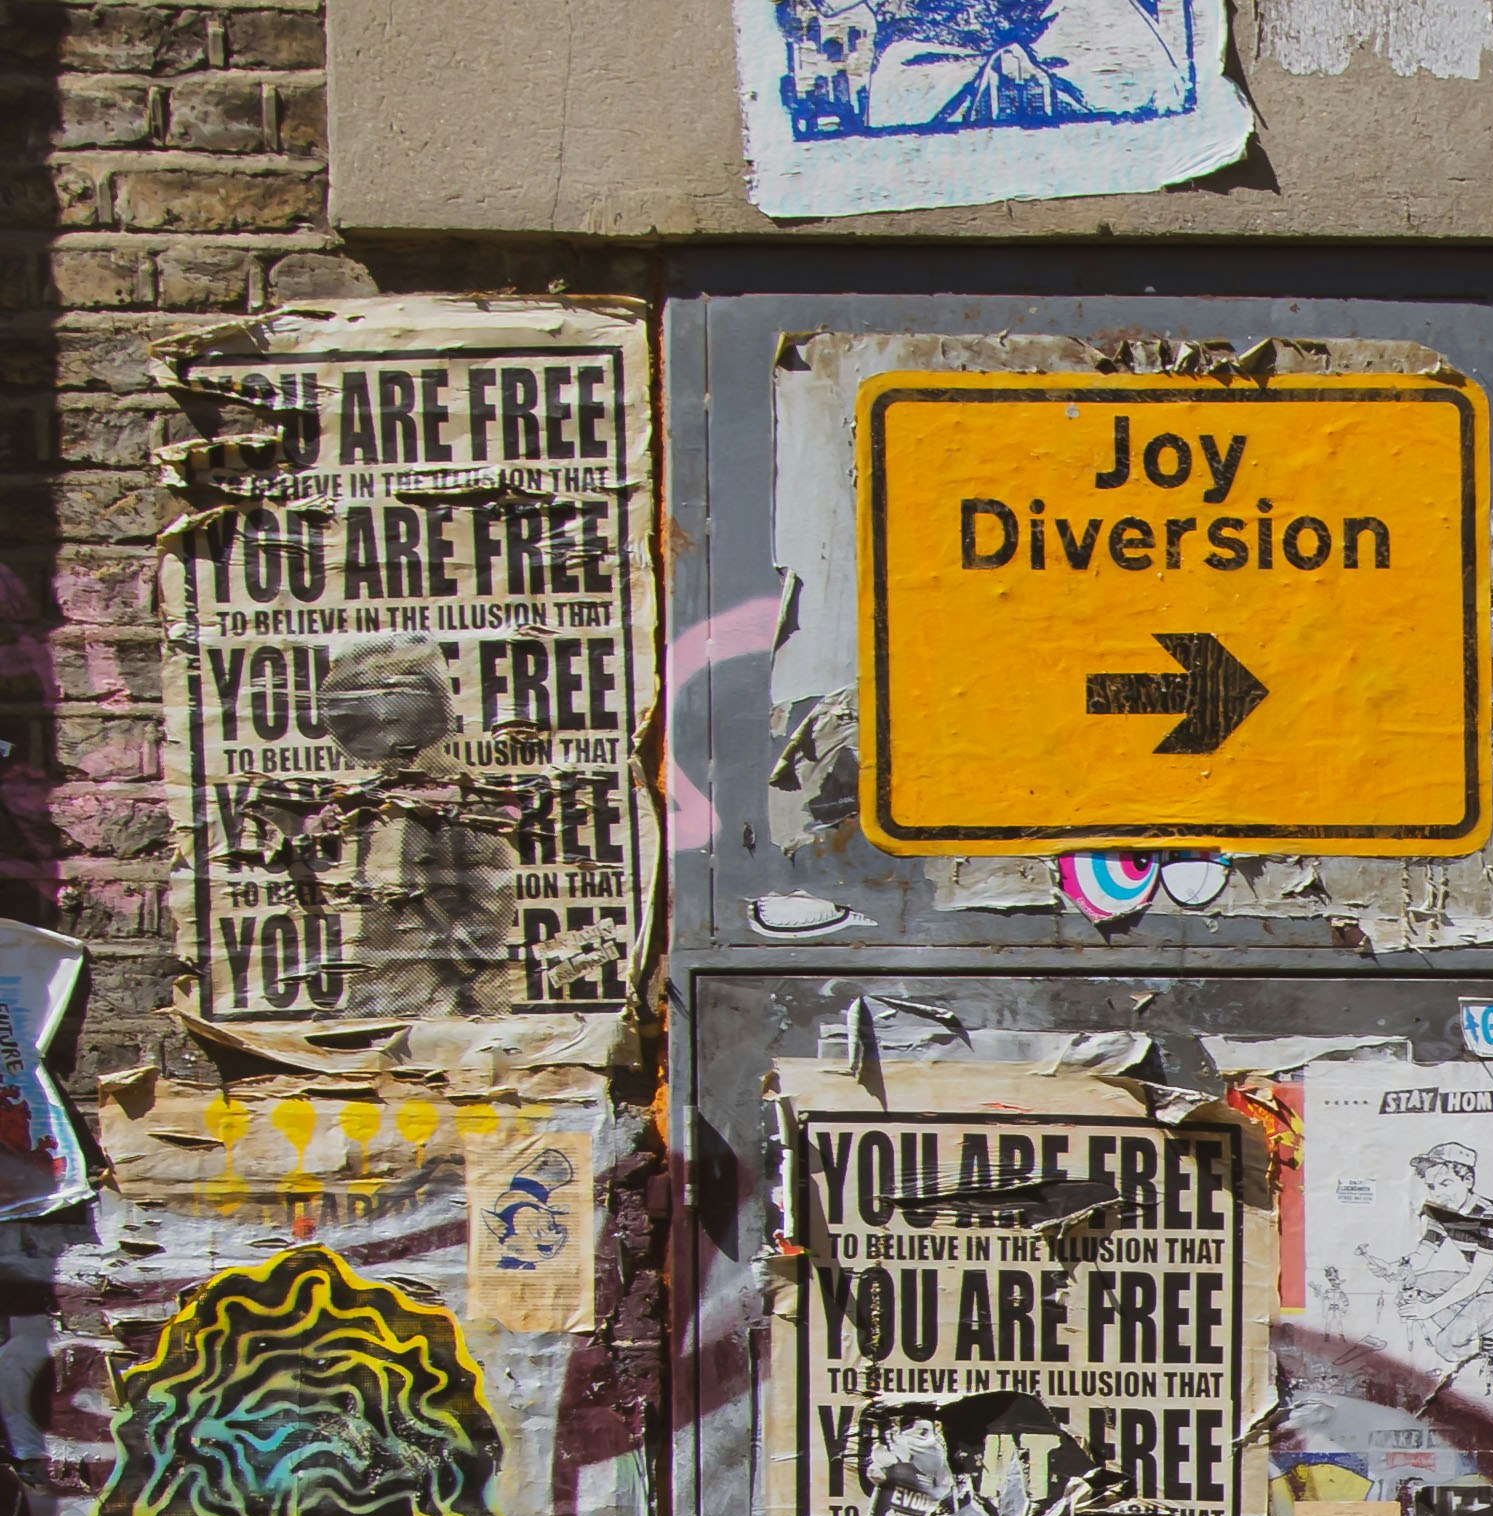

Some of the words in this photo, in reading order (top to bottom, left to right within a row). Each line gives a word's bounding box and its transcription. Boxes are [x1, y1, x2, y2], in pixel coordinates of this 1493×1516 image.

[340, 369, 452, 465] ARE
[469, 366, 609, 462] FREE
[1096, 414, 1247, 503] Joy
[202, 505, 327, 604] YOU
[344, 506, 458, 599] ARE
[472, 500, 613, 596] FREE
[960, 499, 1391, 571] Diversion
[217, 611, 248, 637] TO
[255, 609, 347, 635] BELIEVE
[355, 608, 379, 634] IN
[386, 606, 430, 633] THE
[438, 602, 545, 632] ILLUSION
[553, 601, 612, 628] THAT
[480, 638, 618, 733] FREE
[224, 748, 255, 775] TO
[559, 737, 619, 765] THAT
[563, 871, 625, 899] THAT
[220, 914, 343, 1010] YOU
[1385, 1089, 1435, 1113] STAY
[817, 1131, 939, 1228] YOU
[829, 1232, 859, 1260] TO
[865, 1233, 959, 1262] BELIEVE
[966, 1236, 992, 1261] IN
[998, 1236, 1042, 1263] THE
[1048, 1236, 1158, 1265] ILLUSION
[1165, 1238, 1225, 1265] THAT
[815, 1267, 938, 1363] YOU
[954, 1268, 1070, 1363] ARE
[1087, 1271, 1224, 1365] FREE
[827, 1367, 857, 1394] TO
[865, 1366, 959, 1395] BELIEVE
[966, 1368, 991, 1394] IN
[1047, 1370, 1157, 1398] ILLUSION
[1164, 1371, 1224, 1399] THAT
